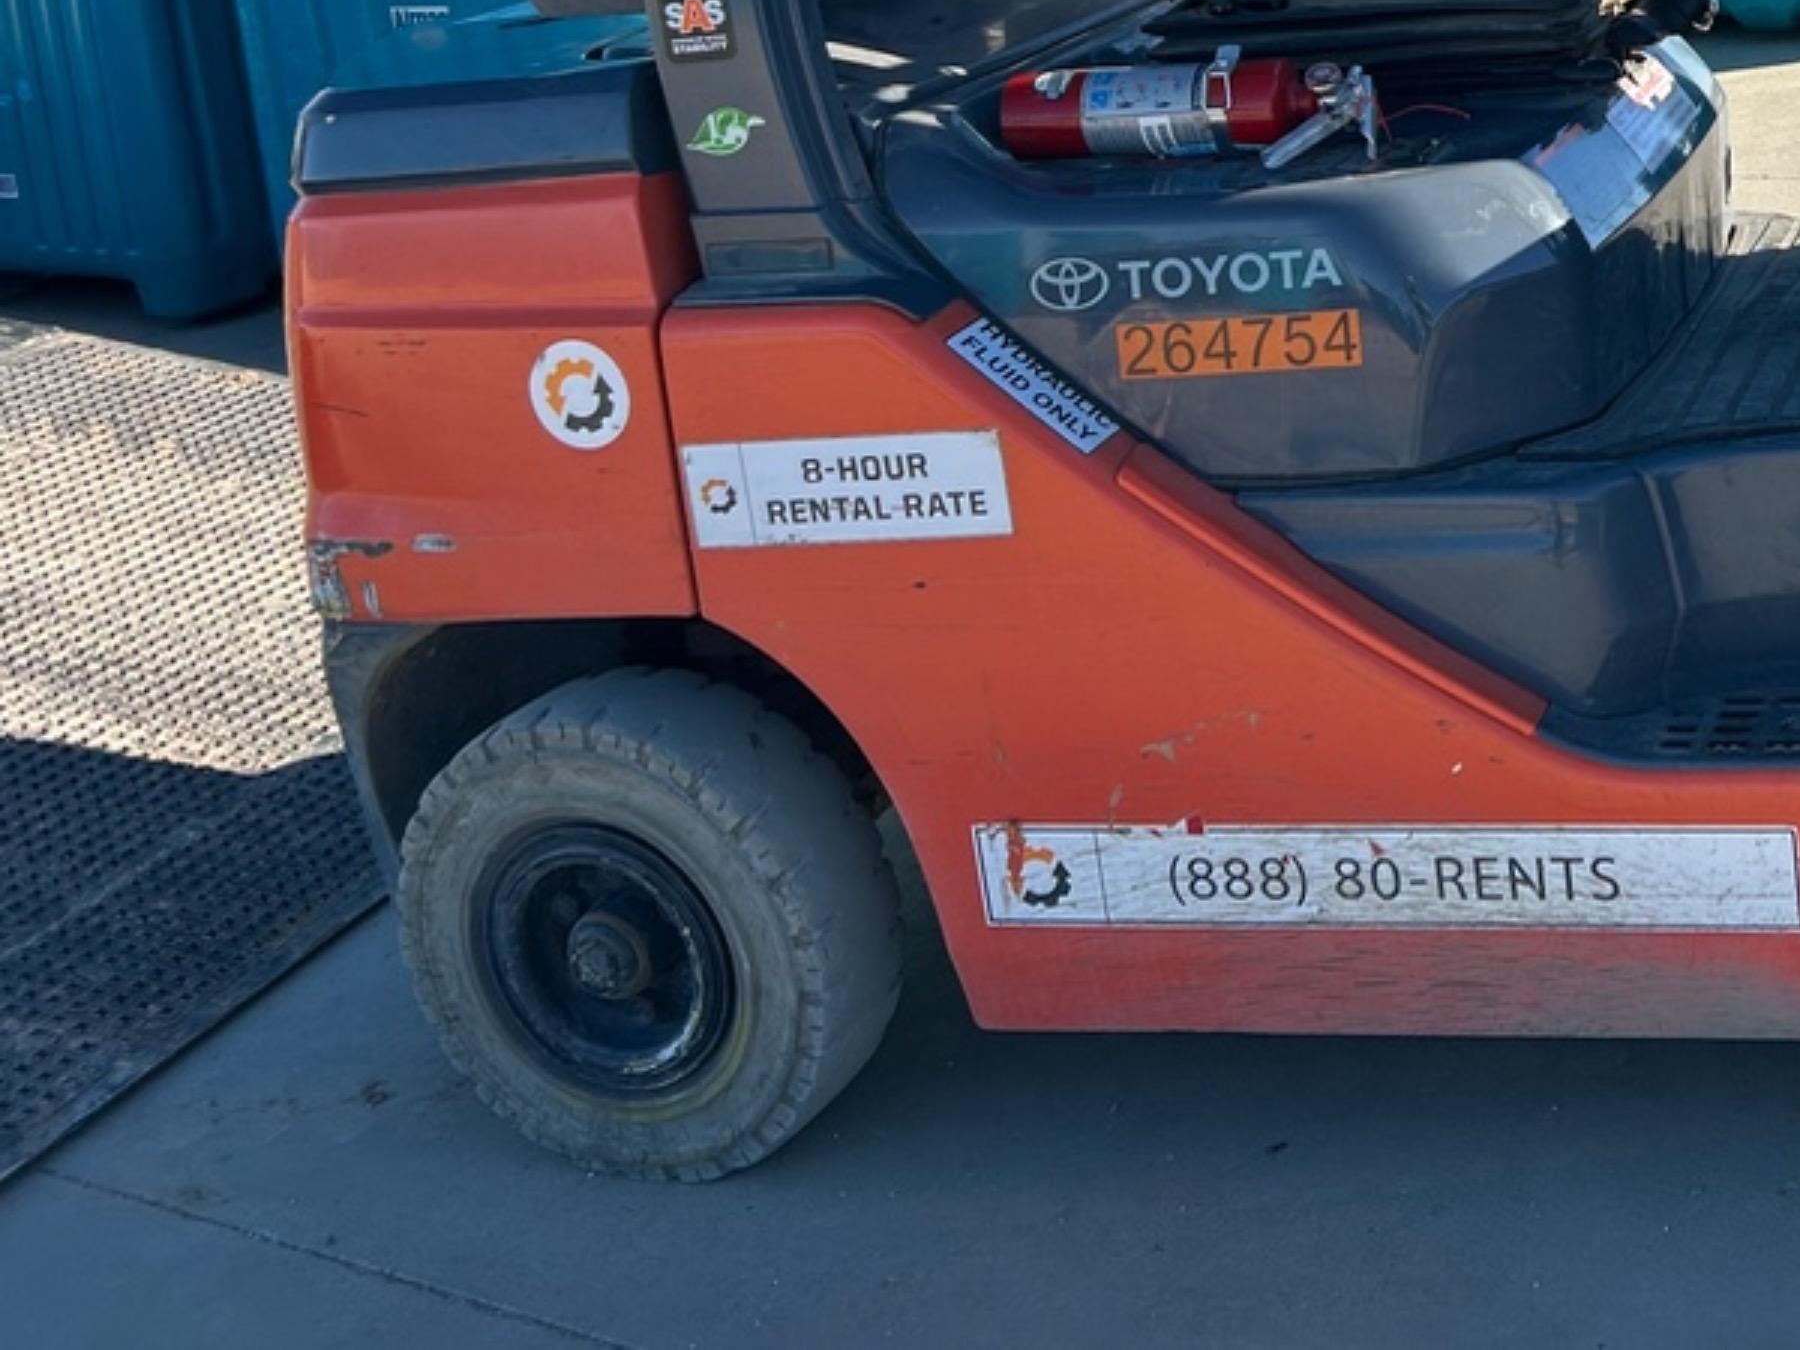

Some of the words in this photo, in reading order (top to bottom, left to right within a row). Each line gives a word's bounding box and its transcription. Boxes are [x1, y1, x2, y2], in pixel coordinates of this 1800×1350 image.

[1119, 248, 1342, 300] TOYOTA
[1121, 313, 1360, 378] 264754
[961, 335, 1031, 391] FLUID
[1032, 392, 1098, 440] ONLY
[800, 453, 929, 484] 8-HOUR
[766, 498, 892, 525] RENTAL
[903, 490, 989, 519] RATE
[1168, 855, 1308, 906] (888)
[1333, 856, 1622, 902] 80-RENTS
